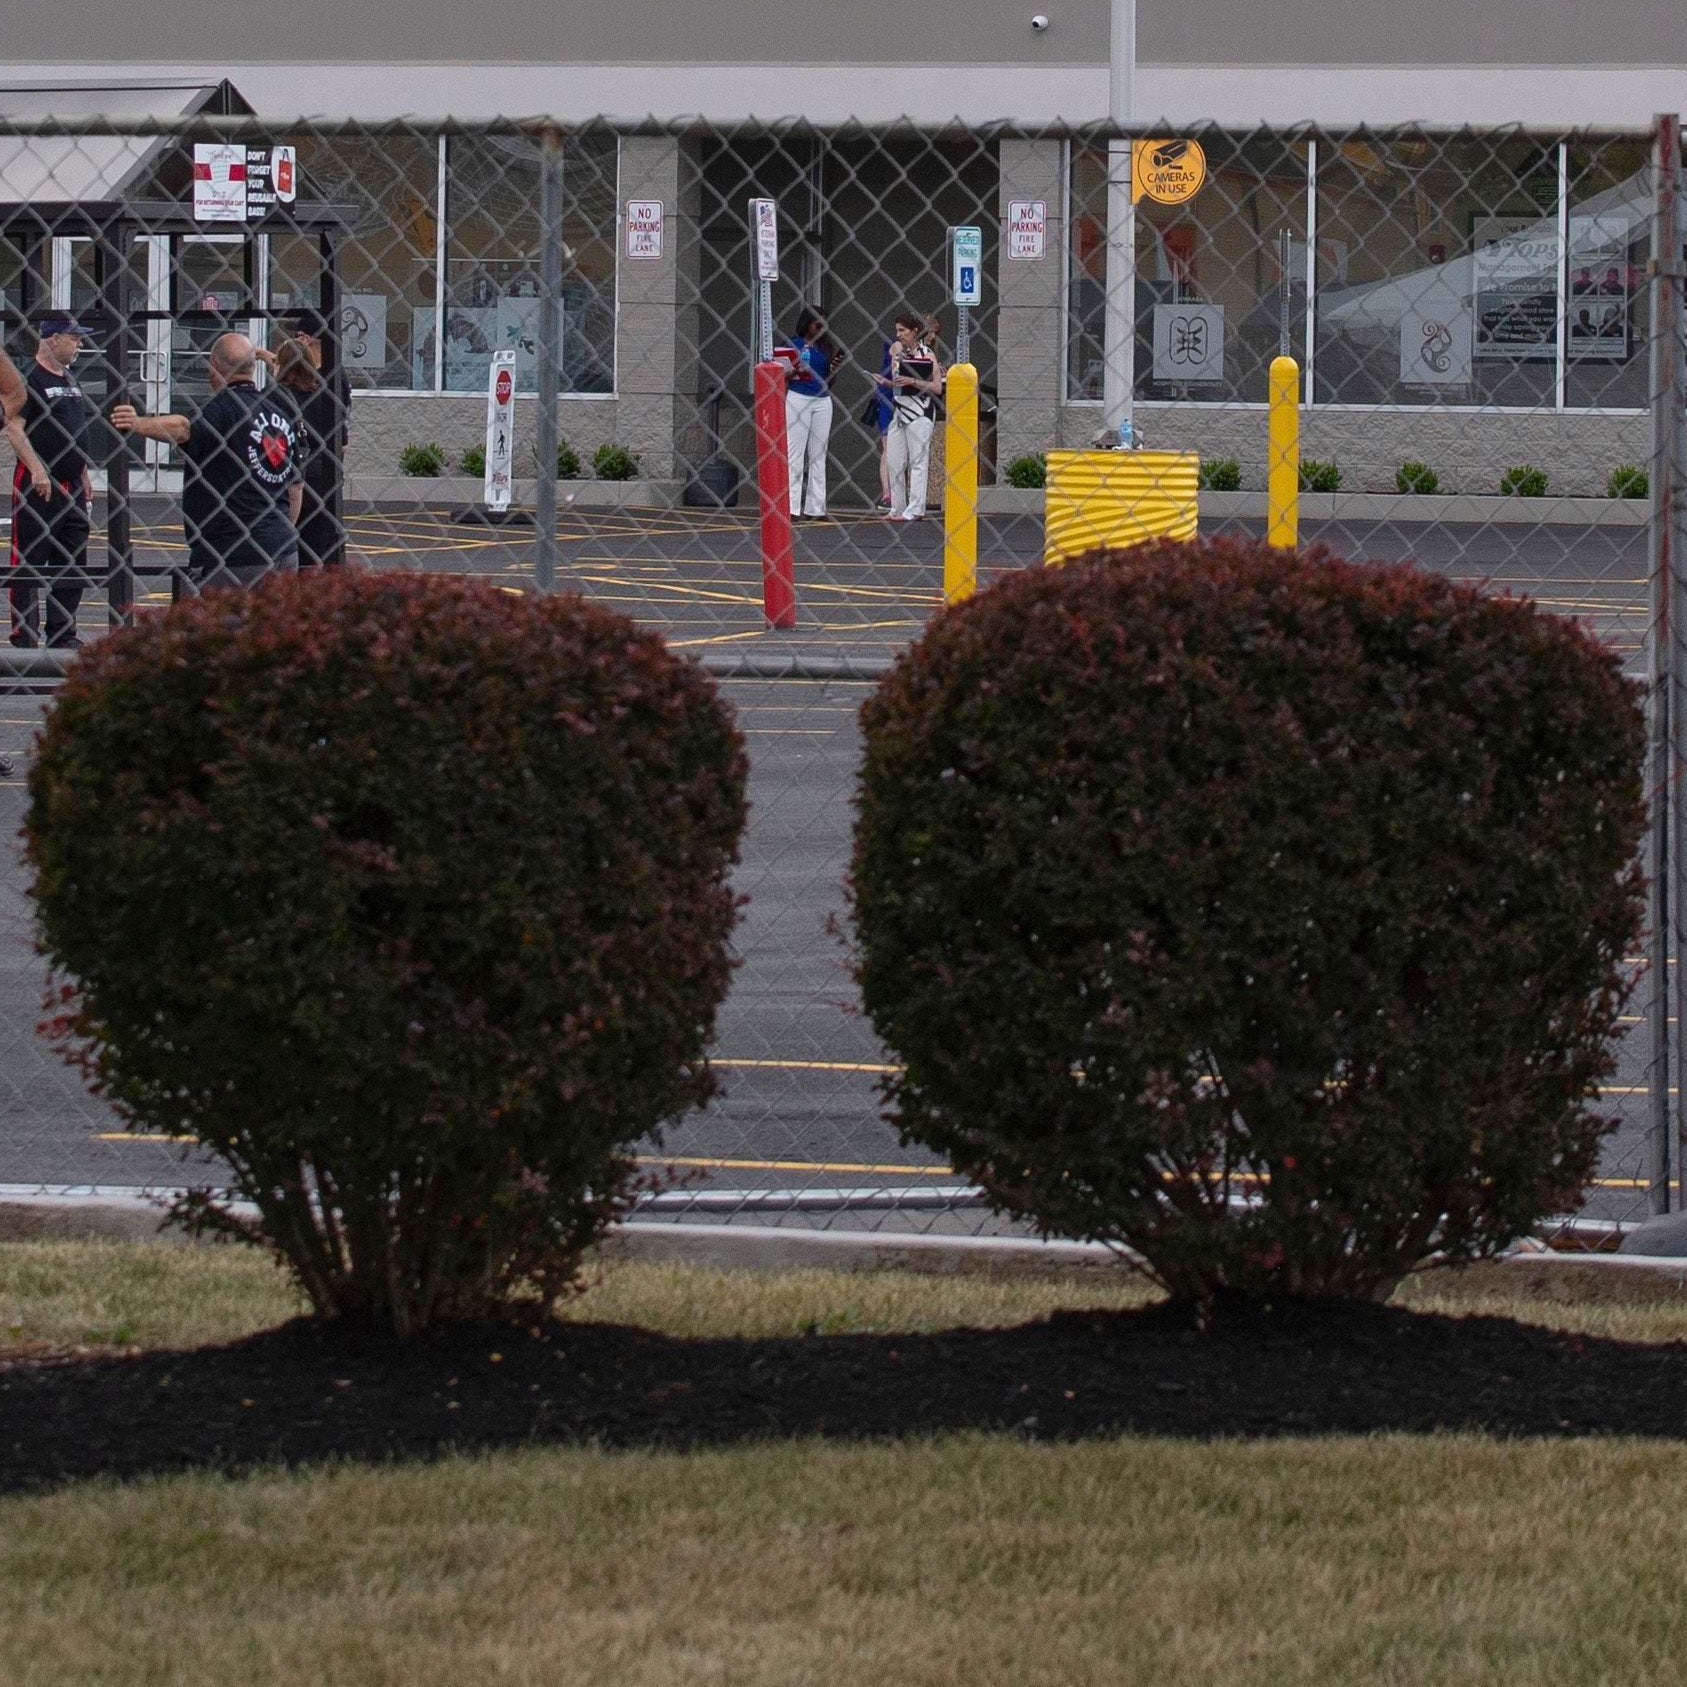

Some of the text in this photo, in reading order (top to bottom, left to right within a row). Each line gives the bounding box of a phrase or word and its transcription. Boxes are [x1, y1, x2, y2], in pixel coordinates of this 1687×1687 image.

[1147, 172, 1195, 183] CAMERAS
[1156, 183, 1187, 194] IN USE
[638, 208, 652, 219] NO
[1020, 208, 1034, 219] NO
[629, 221, 660, 232] PARKING
[1012, 221, 1042, 233] PARKING
[637, 234, 652, 243] FIRE
[1019, 234, 1035, 244] FIRE
[636, 244, 653, 253] LANE
[1018, 245, 1036, 253] LANE
[496, 382, 511, 394] STOP
[250, 412, 295, 446] ALL ONE
